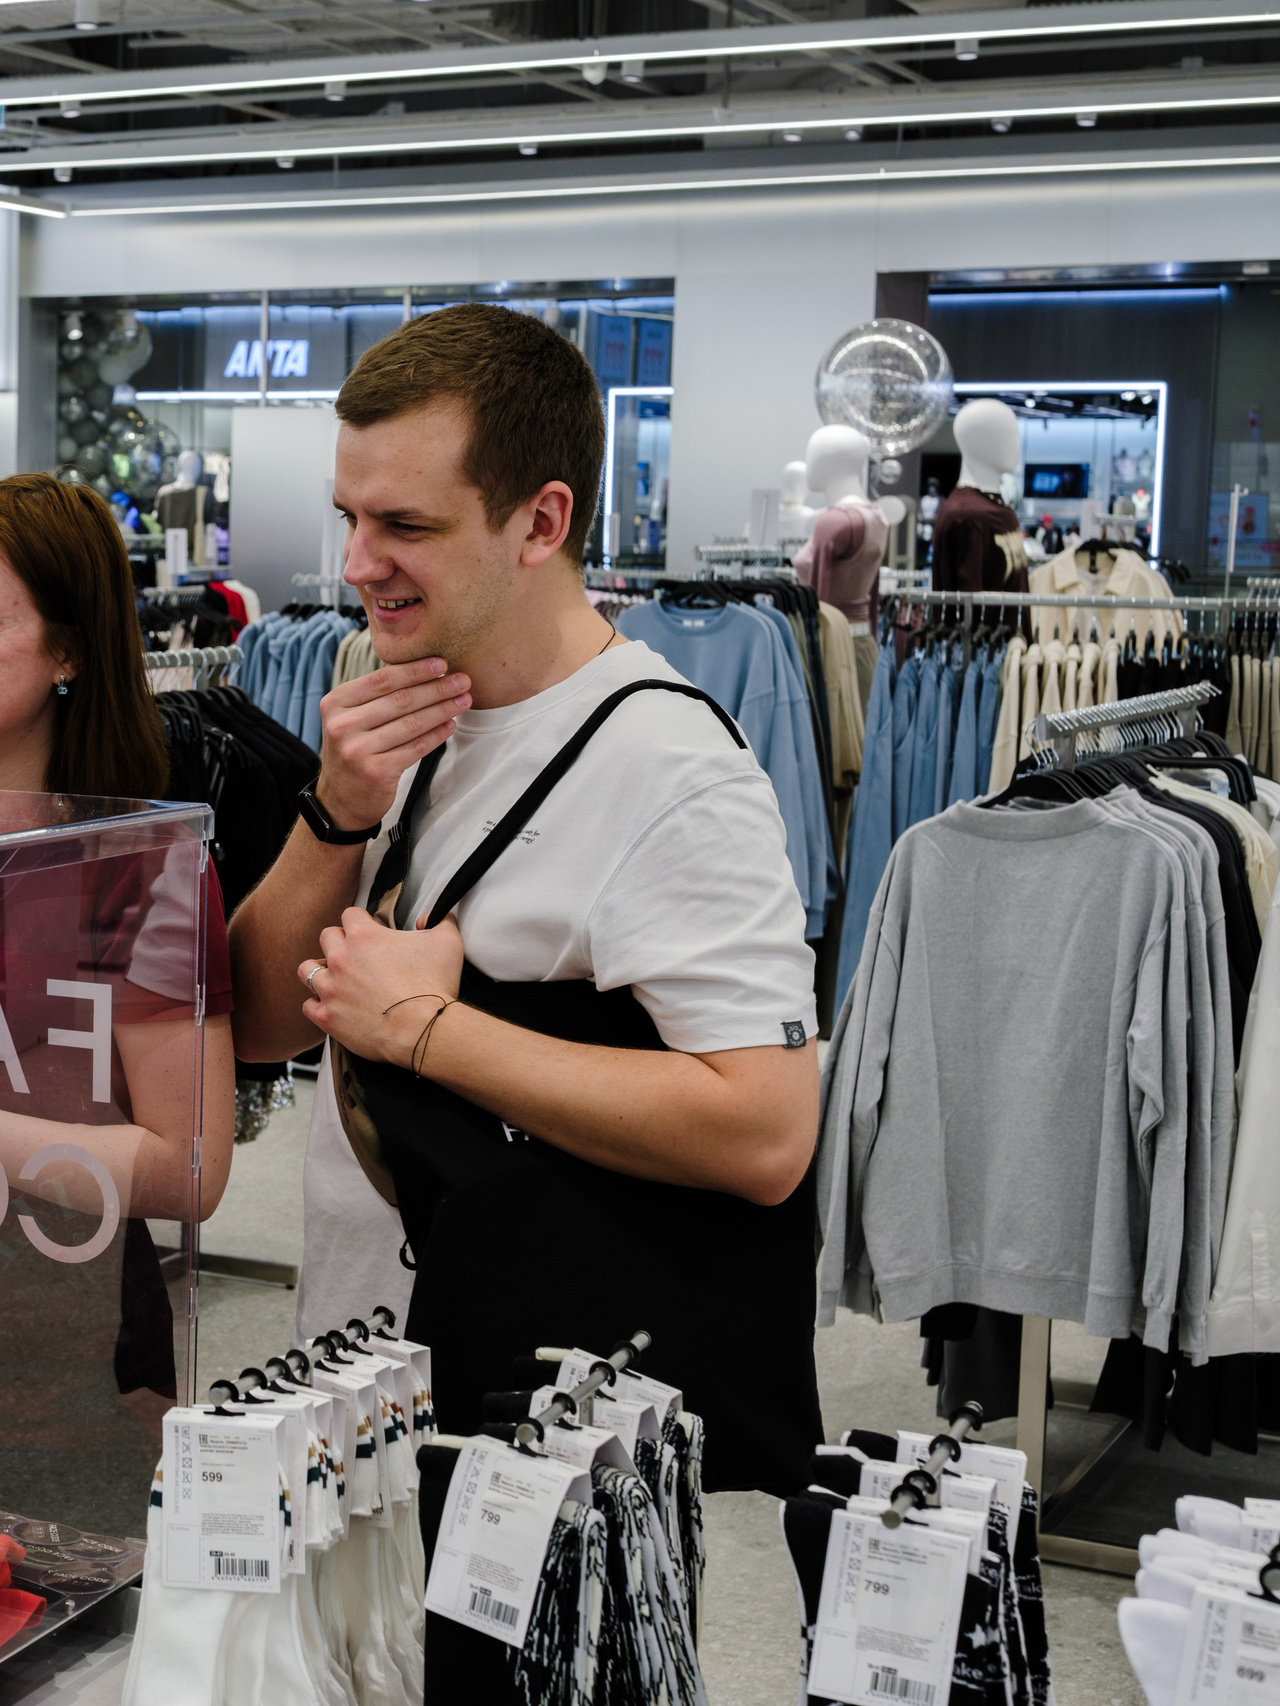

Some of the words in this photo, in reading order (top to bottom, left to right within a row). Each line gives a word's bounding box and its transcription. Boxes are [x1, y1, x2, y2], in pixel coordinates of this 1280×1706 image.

[224, 340, 309, 377] ANTA
[202, 1471, 223, 1482] 599
[481, 1508, 501, 1525] 799
[79, 1575, 110, 1584] CODE
[864, 1579, 889, 1596] 799
[1236, 1665, 1266, 1683] 699
